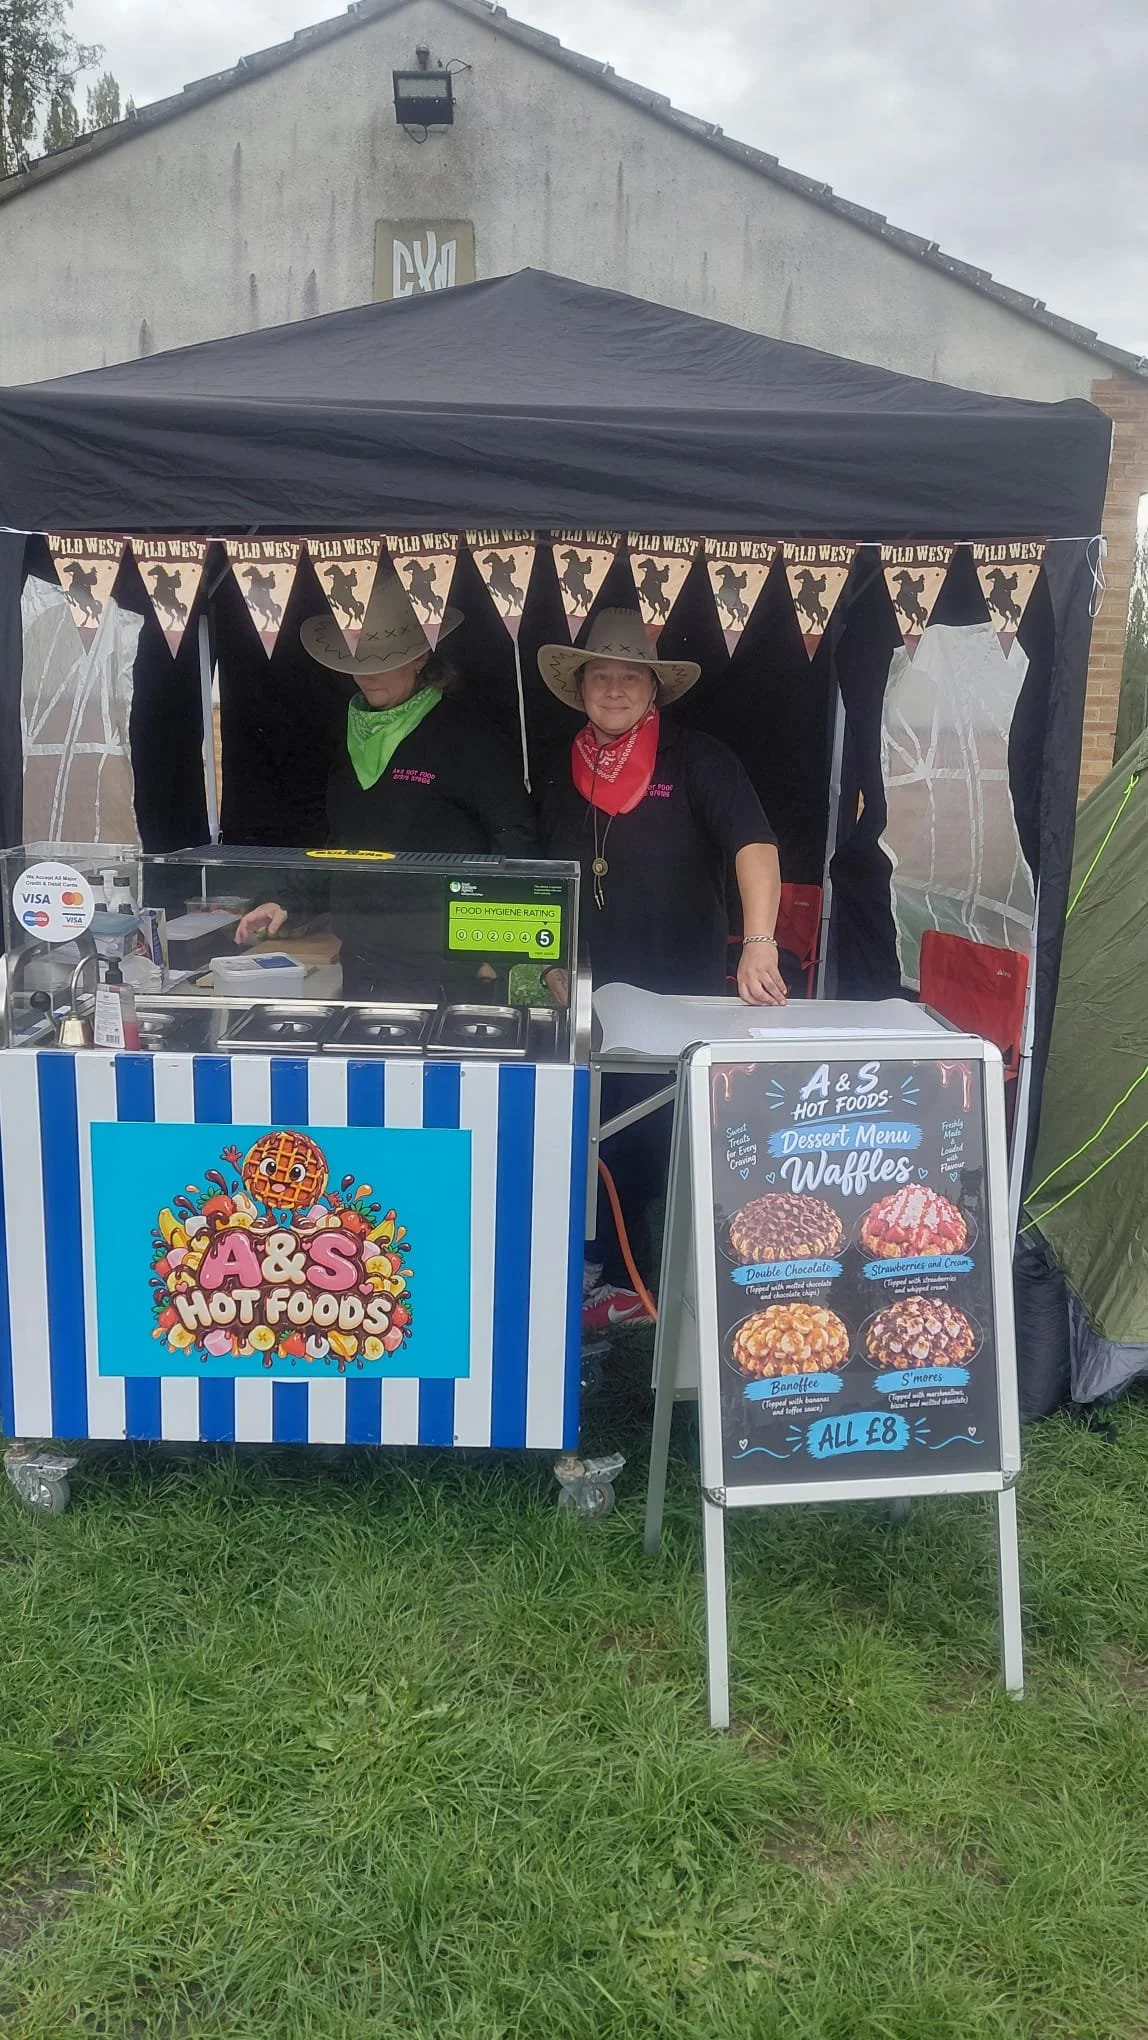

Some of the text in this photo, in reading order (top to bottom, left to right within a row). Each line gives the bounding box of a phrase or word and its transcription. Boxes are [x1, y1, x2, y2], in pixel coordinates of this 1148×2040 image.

[48, 535, 123, 557] WILD WEST
[386, 533, 459, 553] WILD WEST
[465, 529, 536, 546] WILD WEST
[586, 530, 621, 549] WEST
[627, 531, 699, 556] WILD WEST
[131, 538, 206, 560] WILD WEST
[226, 540, 299, 560] WILD WEST
[307, 538, 380, 558] WILD WEST
[704, 538, 777, 562] WILD WEST
[783, 542, 855, 565] WILD WEST
[880, 545, 952, 564] WILD WEST
[973, 542, 1045, 561] WILD WEST
[22, 893, 51, 904] VISA
[455, 906, 555, 917] FOOD HYGIENE RATING
[539, 931, 550, 946] 5
[800, 1061, 881, 1101] A & S
[791, 1090, 889, 1121] HOT FOODS
[726, 1122, 748, 1138] Sweet
[942, 1119, 964, 1132] Freshly
[944, 1128, 962, 1139] Made
[728, 1134, 751, 1148] Treats
[780, 1125, 911, 1153] Dessert Menu
[726, 1143, 757, 1161] for Every
[940, 1142, 964, 1156] Loaded
[946, 1153, 959, 1162] with
[730, 1155, 757, 1170] Craving
[940, 1161, 966, 1174] Flavour
[780, 1148, 914, 1196] Waffles
[199, 1231, 357, 1291] A&S
[871, 1258, 969, 1277] Strawberries and Cream
[746, 1261, 833, 1281] Double Chocolate
[745, 1280, 832, 1295] (Topped with melted chocolate
[883, 1275, 957, 1288] (Topped with strawberries
[895, 1283, 949, 1294] and whipped cream)
[760, 1289, 820, 1300] and chocolate chips)
[175, 1288, 392, 1334] HOT FOODS
[771, 1377, 821, 1395] Banoffee
[902, 1372, 943, 1387] S'mores
[761, 1395, 830, 1409] (Topped with bananas
[888, 1392, 911, 1402] (Topped
[912, 1391, 925, 1399] with
[890, 1396, 969, 1409] biscuit and melted chocolate)
[772, 1404, 823, 1416] and toffee sauce)
[818, 1417, 898, 1451] ALL £8
